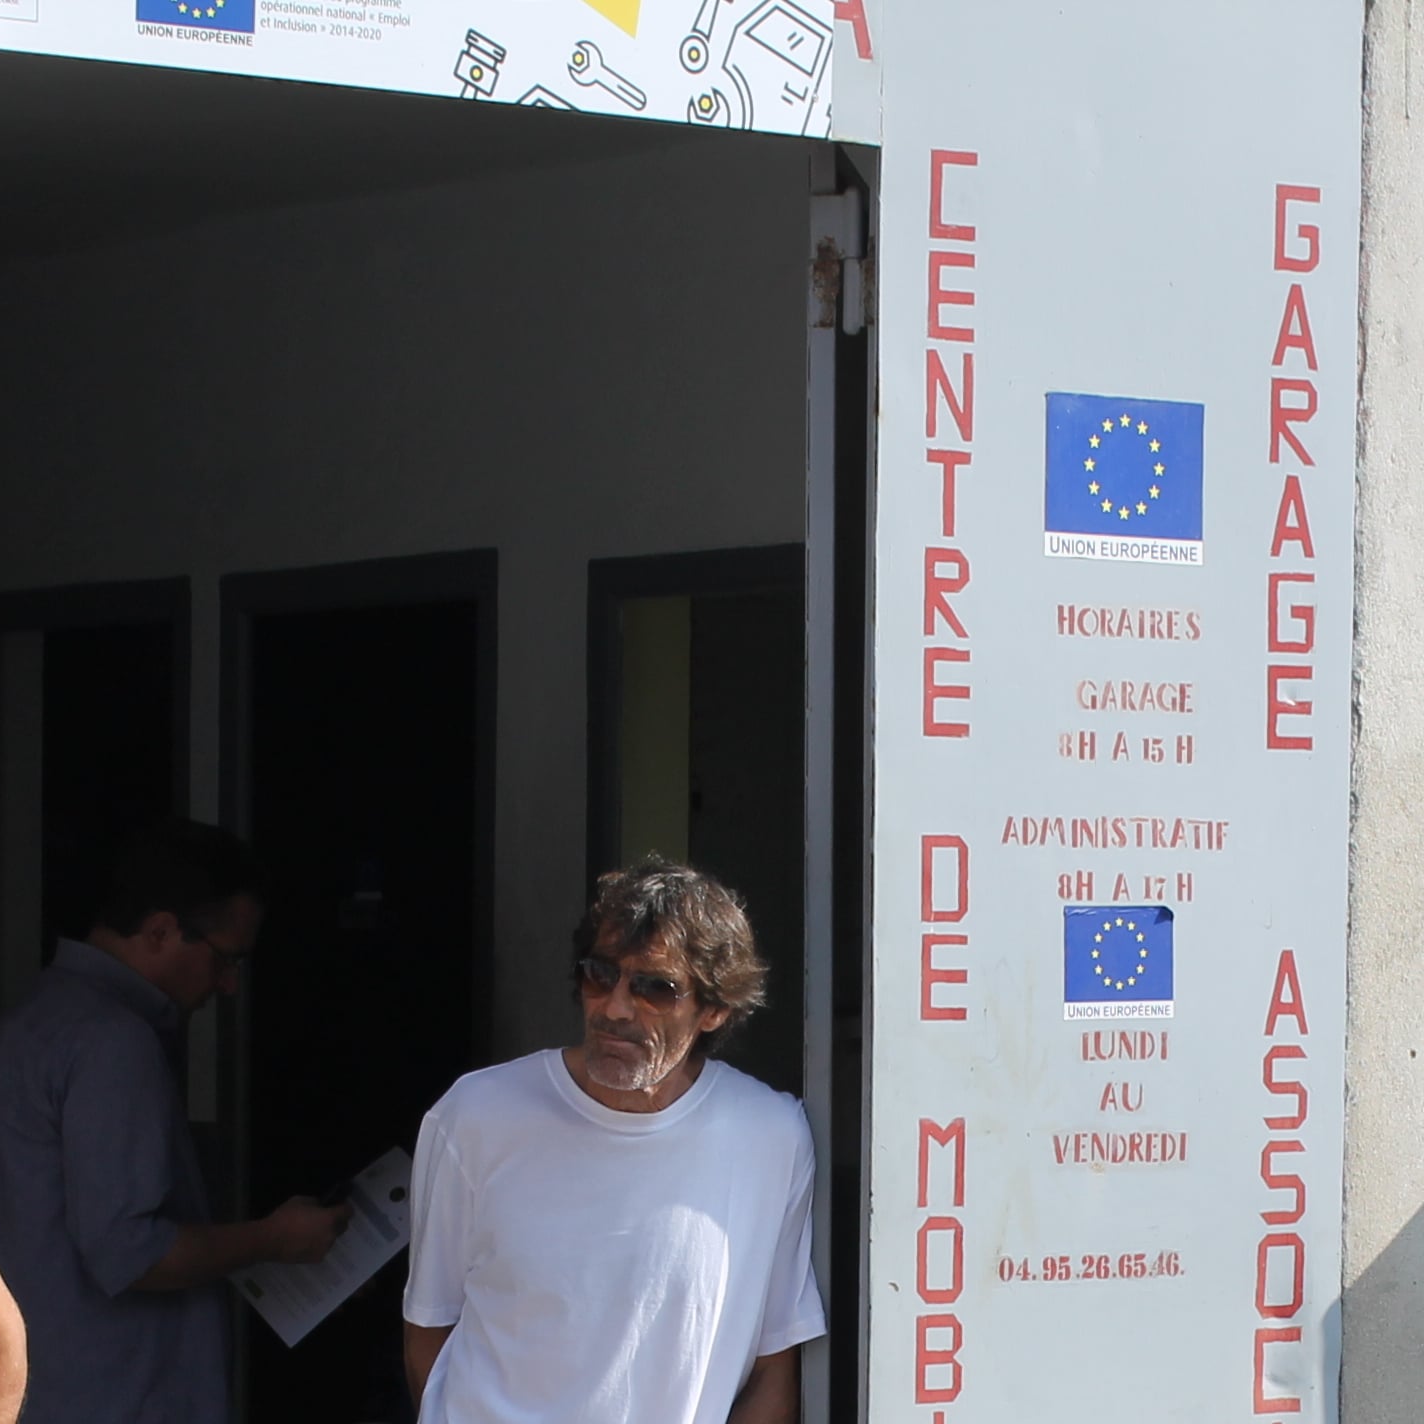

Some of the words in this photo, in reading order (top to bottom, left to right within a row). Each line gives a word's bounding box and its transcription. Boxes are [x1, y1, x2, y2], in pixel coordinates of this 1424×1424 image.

[260, 1, 324, 17] opérationnel
[326, 7, 366, 22] national
[378, 12, 411, 27] Emploi
[260, 17, 271, 28] et
[274, 18, 317, 33] Inclusion
[329, 23, 382, 41] 2014-2020
[137, 23, 174, 38] UNION
[176, 27, 253, 47] EUROPÉENNE
[922, 148, 979, 738] CENTRE
[1266, 184, 1321, 750] GARAGE
[1049, 535, 1096, 557] UNION
[1100, 539, 1198, 563] EUROPÉENNE
[1057, 604, 1201, 641] HORAIRES
[1077, 679, 1194, 713] GARAGE
[1112, 731, 1130, 762] A
[1142, 737, 1165, 763] 15
[1176, 734, 1193, 764] H
[1001, 816, 1229, 850] ADMINISTRATIF
[1112, 873, 1131, 902] A
[1144, 875, 1166, 901] 17
[1177, 873, 1193, 902] H
[919, 834, 969, 1021] DE
[1067, 1004, 1101, 1018] UNION
[1103, 1002, 1171, 1017] EUROPÉENNE
[1082, 1031, 1168, 1061] LUNDI
[1100, 1081, 1143, 1112] AU
[1053, 1132, 1187, 1165] VENDREDI
